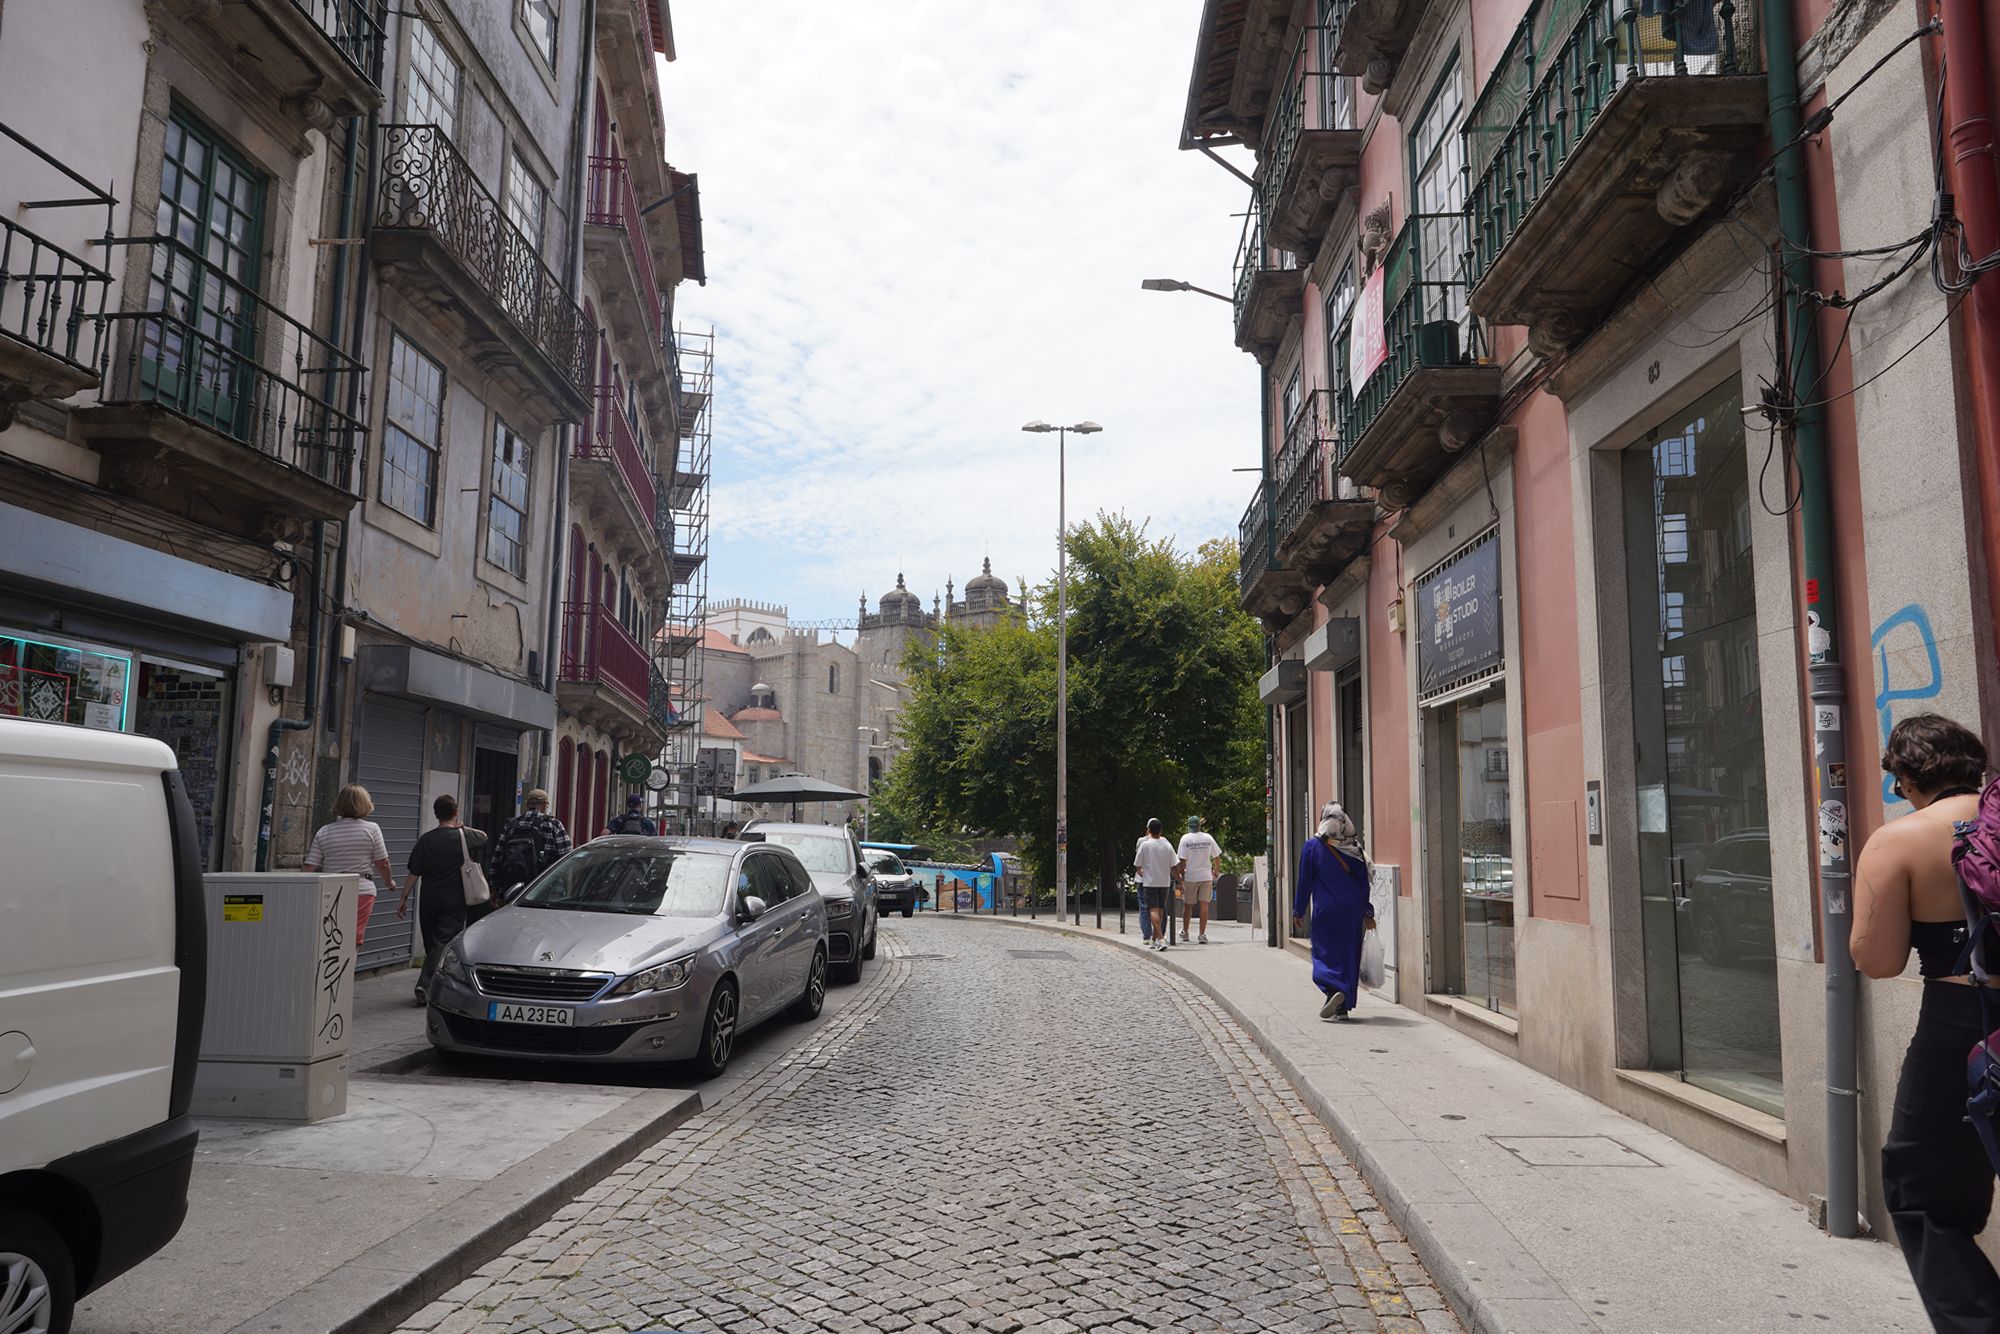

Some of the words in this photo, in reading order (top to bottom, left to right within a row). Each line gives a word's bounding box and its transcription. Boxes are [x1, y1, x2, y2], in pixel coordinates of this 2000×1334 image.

[1648, 360, 1661, 384] 83
[1452, 575, 1476, 600] BOILER
[1453, 598, 1479, 624] STUDIO
